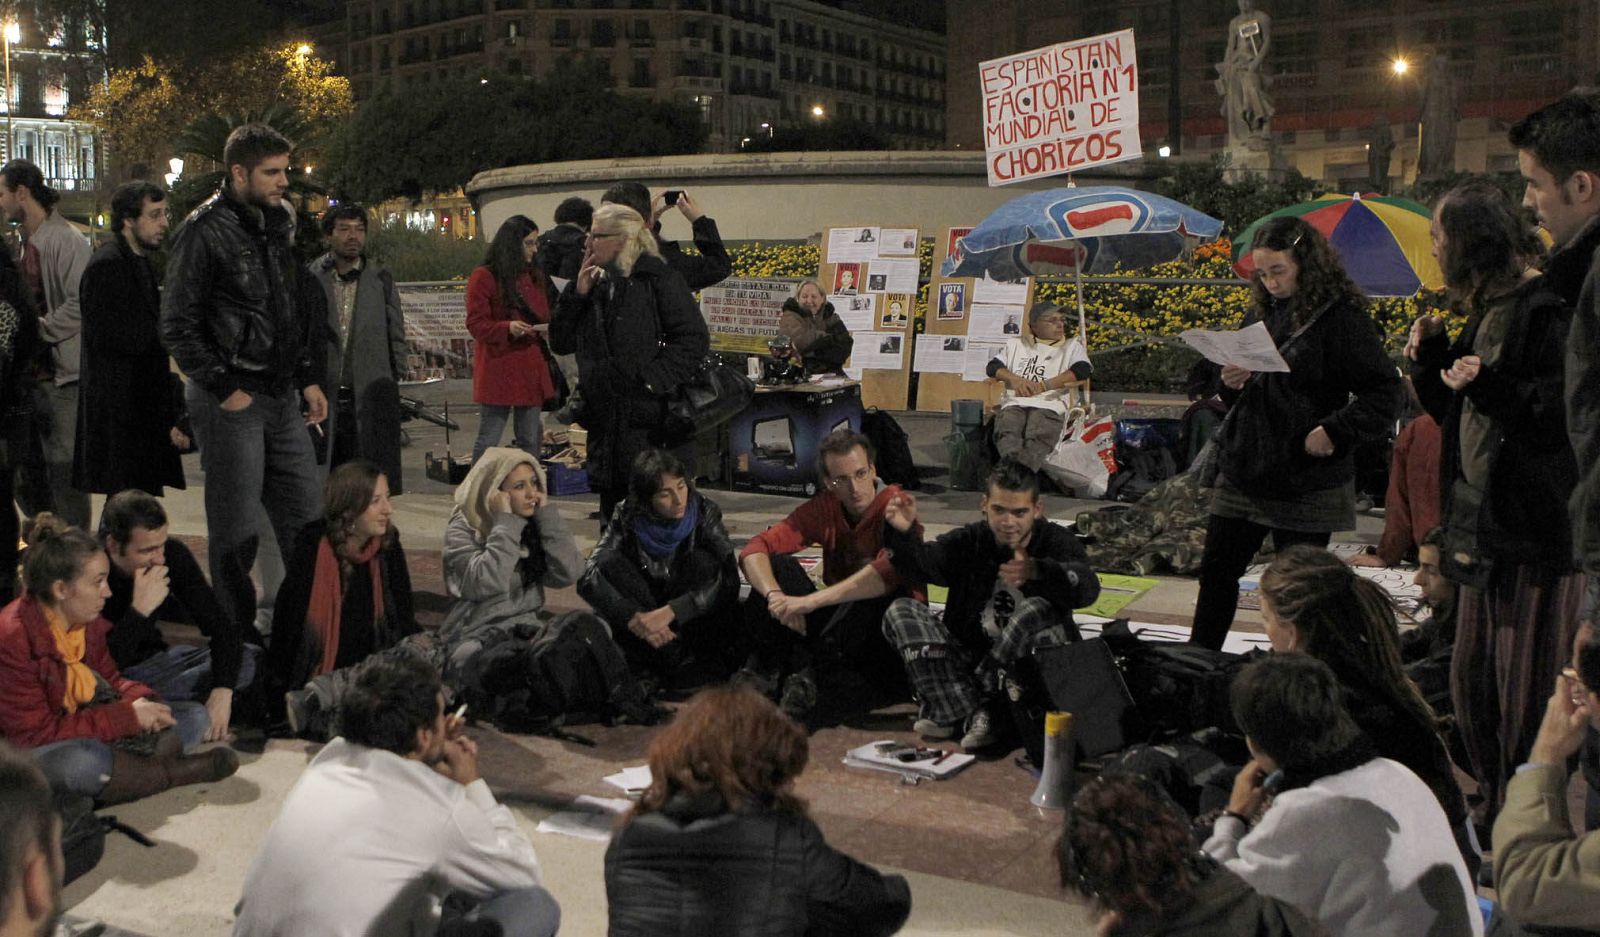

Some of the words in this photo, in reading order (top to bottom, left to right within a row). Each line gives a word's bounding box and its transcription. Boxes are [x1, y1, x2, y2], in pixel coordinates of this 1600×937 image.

[1090, 97, 1121, 127] DE
[993, 130, 1123, 179] CHORIZOS
[840, 263, 858, 271] VOTA
[942, 285, 962, 293] VOTA
[888, 293, 907, 301] VOTA
[748, 327, 757, 335] TU
[758, 328, 778, 337] FUTU
